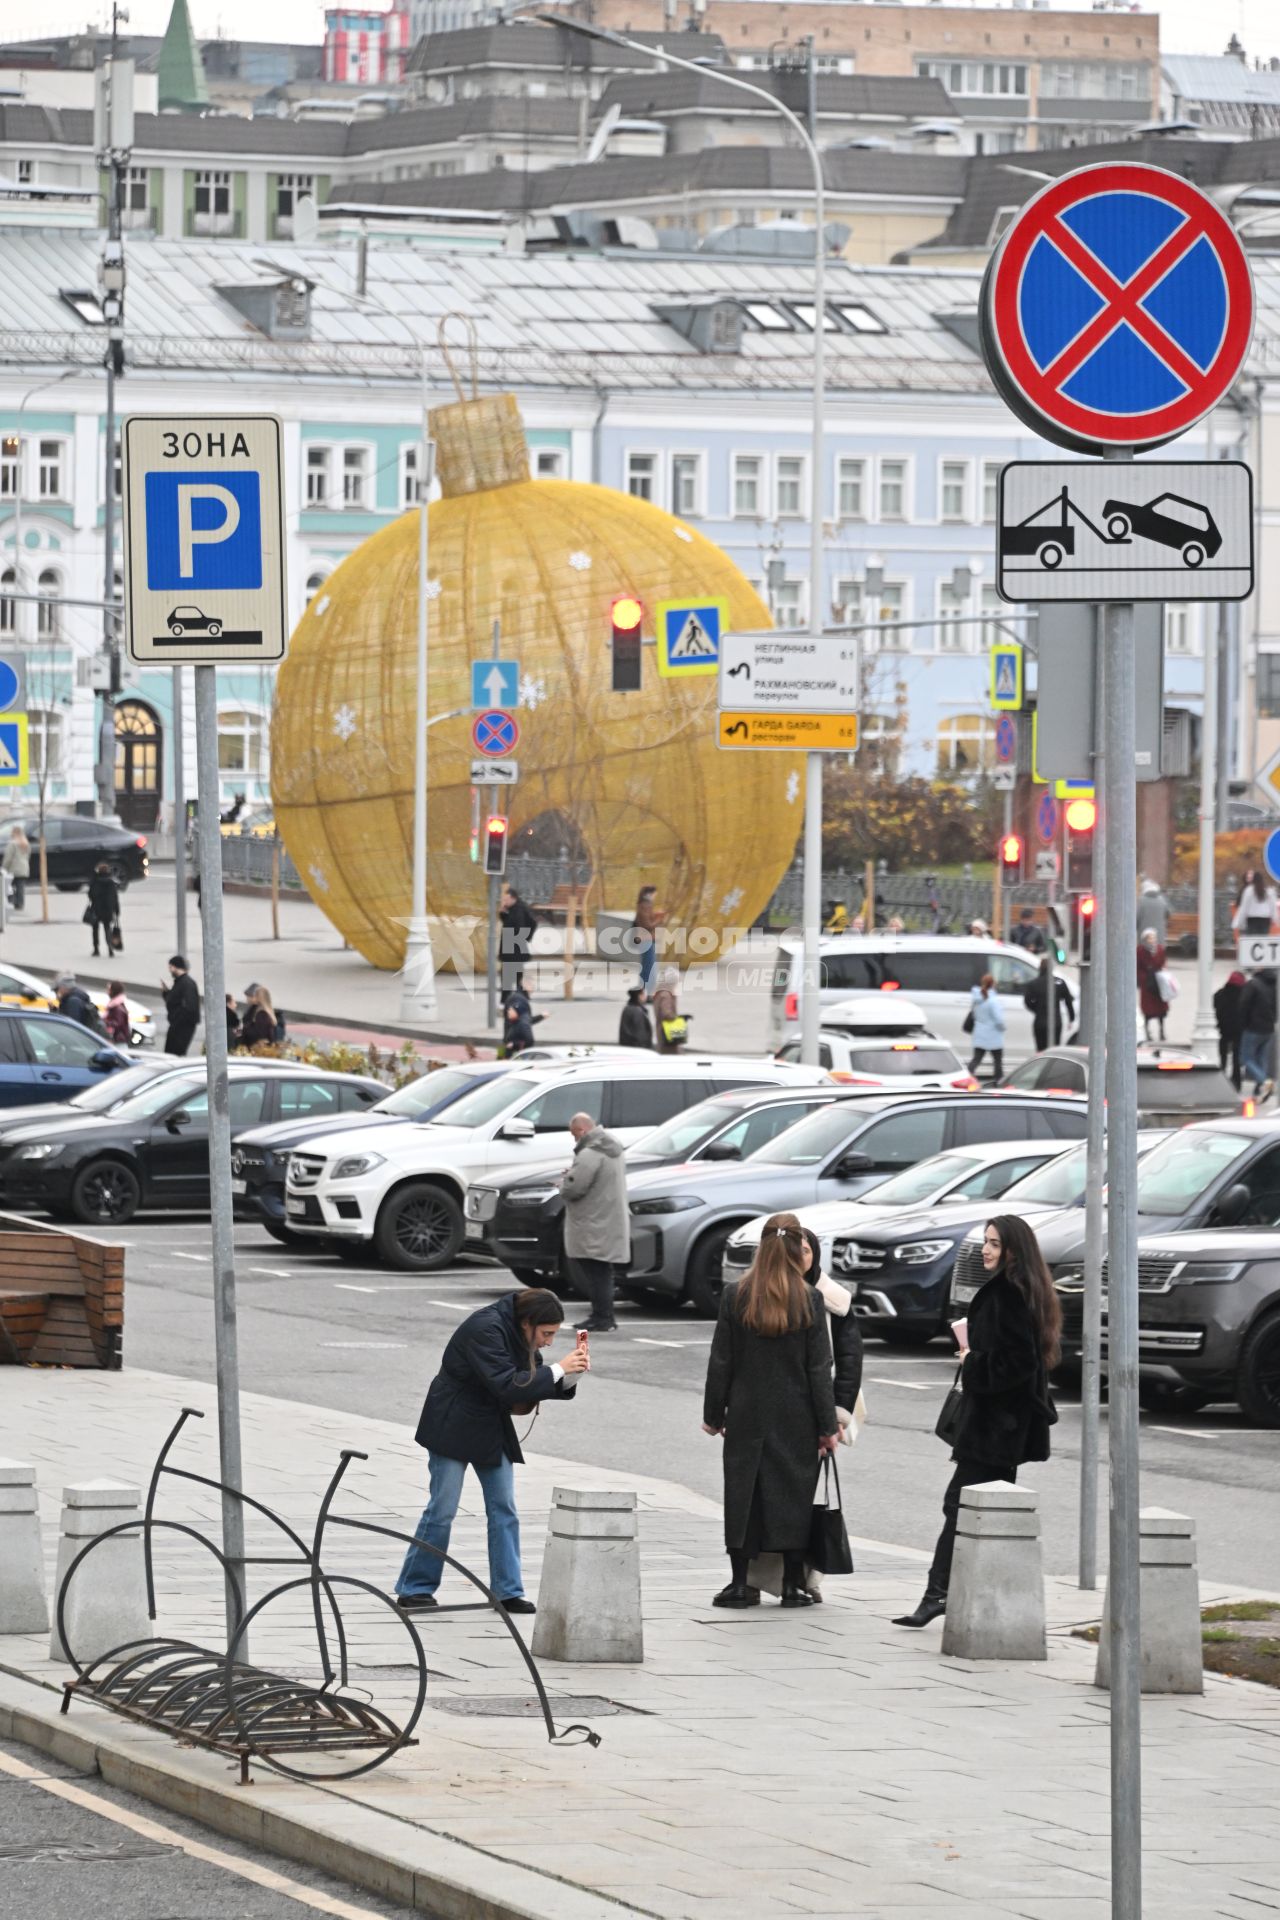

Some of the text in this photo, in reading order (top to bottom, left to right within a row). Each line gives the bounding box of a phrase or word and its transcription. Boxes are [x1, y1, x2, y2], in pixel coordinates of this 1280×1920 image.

[162, 432, 250, 458] ЗОНА
[177, 483, 241, 578] P
[754, 644, 816, 654] НЕГЛИННАЯ
[754, 656, 784, 665] улица
[754, 680, 837, 690] РАХМАНОВСКИЙ
[754, 692, 799, 702] переулок
[752, 720, 782, 731] ГАРДА
[786, 721, 821, 732] GARDA
[752, 733, 796, 742] ресторан
